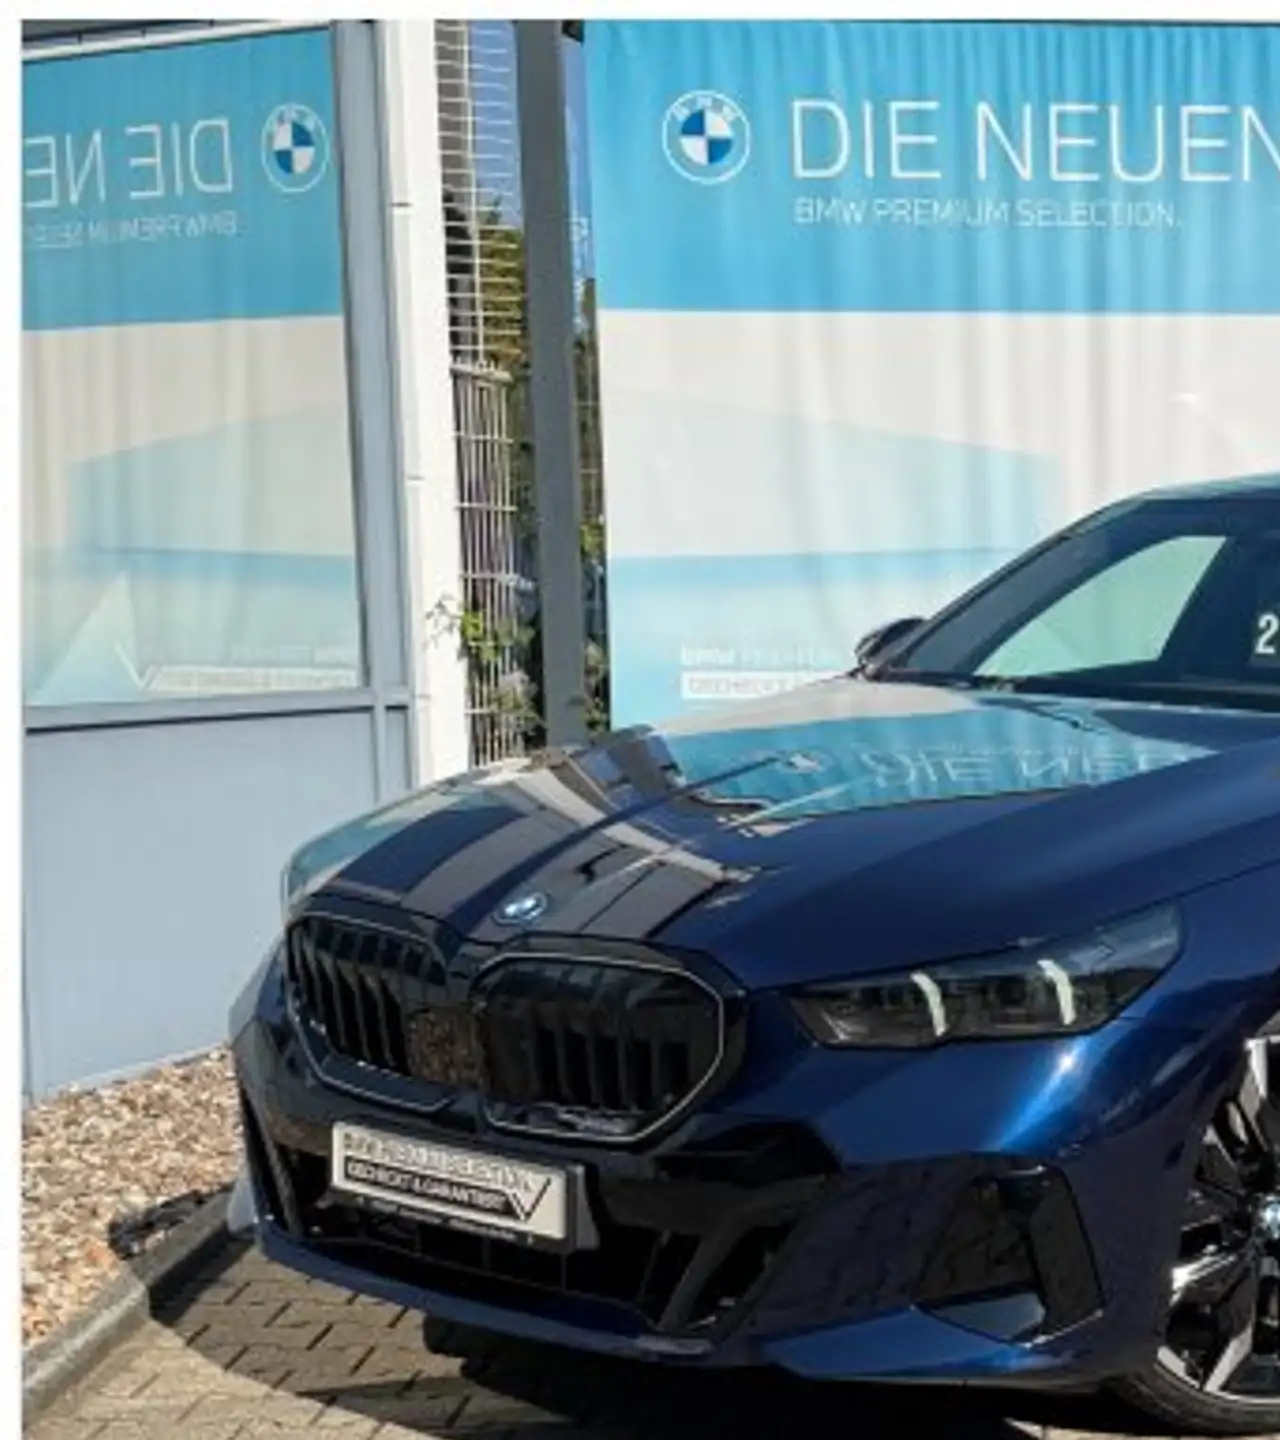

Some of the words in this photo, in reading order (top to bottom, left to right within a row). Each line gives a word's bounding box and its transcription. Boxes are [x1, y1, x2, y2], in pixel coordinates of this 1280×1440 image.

[791, 98, 942, 181] DIE
[793, 196, 868, 227] BMW
[871, 197, 1010, 228] PREMIUM
